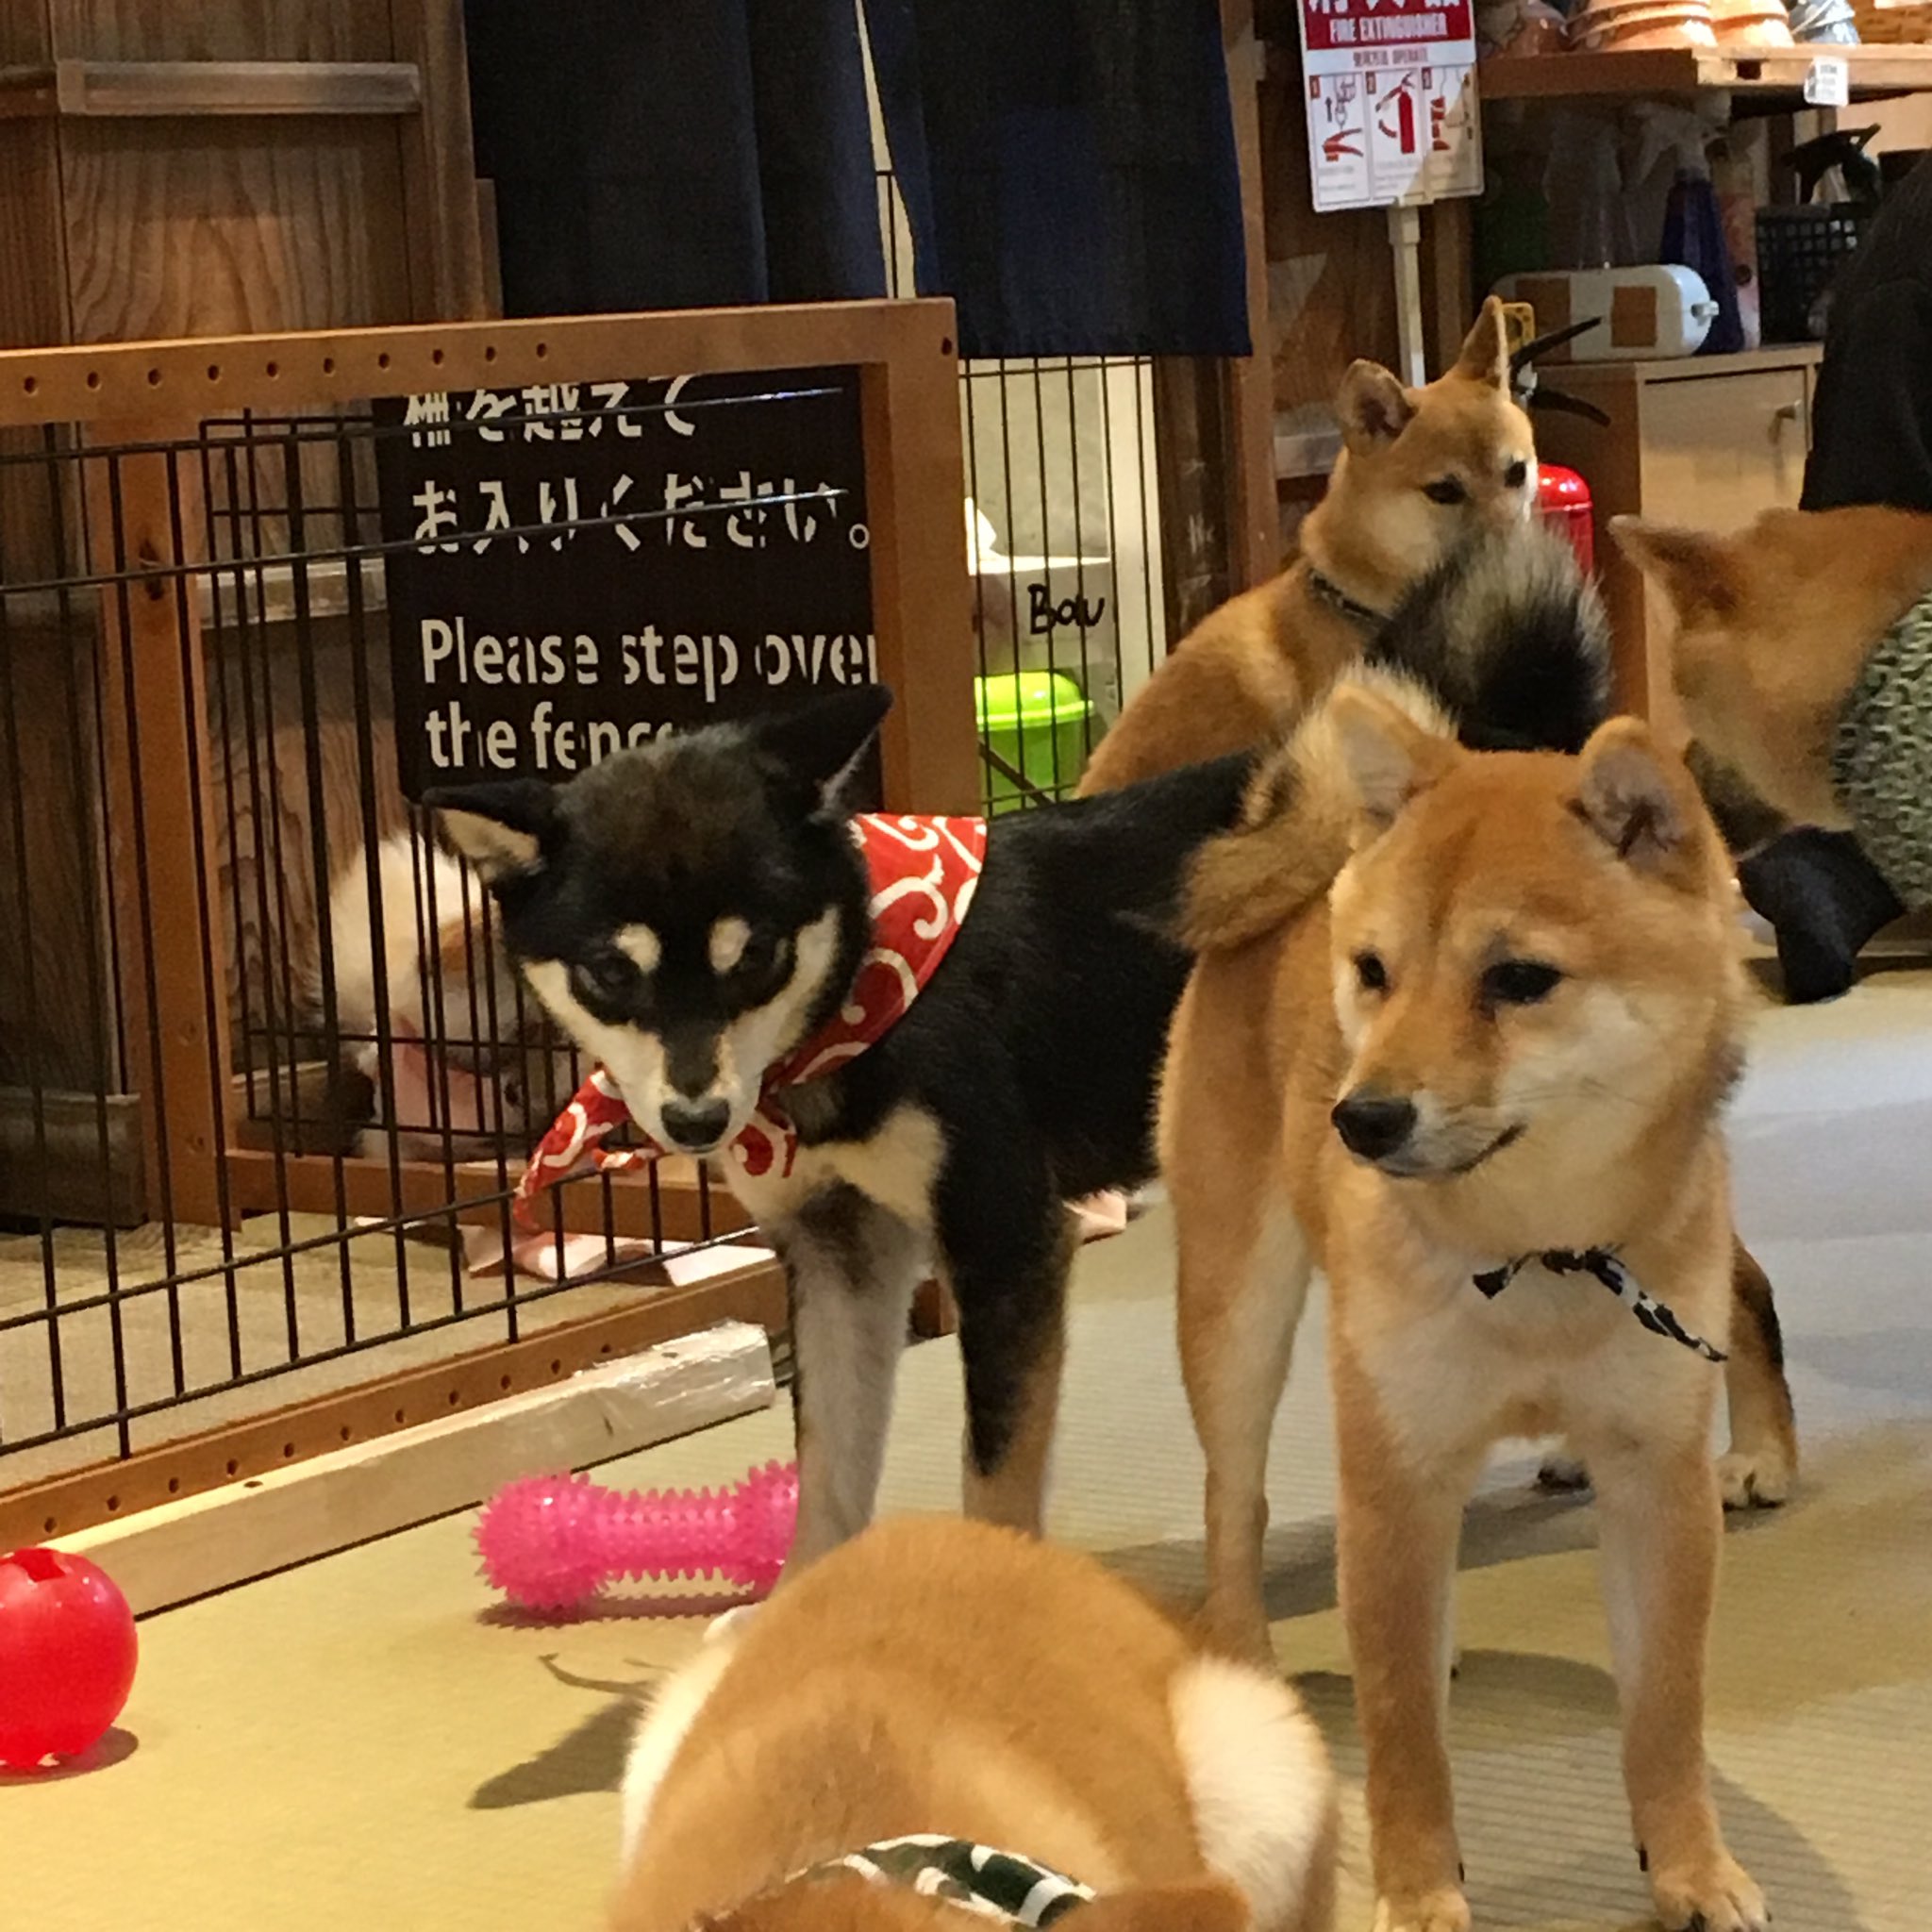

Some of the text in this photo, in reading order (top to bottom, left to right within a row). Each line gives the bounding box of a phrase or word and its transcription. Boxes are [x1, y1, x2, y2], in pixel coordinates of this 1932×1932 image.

[1330, 18, 1357, 43] FIRE
[412, 471, 870, 555] お入りください。
[421, 616, 599, 685] Please
[621, 625, 739, 703] step
[425, 700, 674, 770] the fenc
